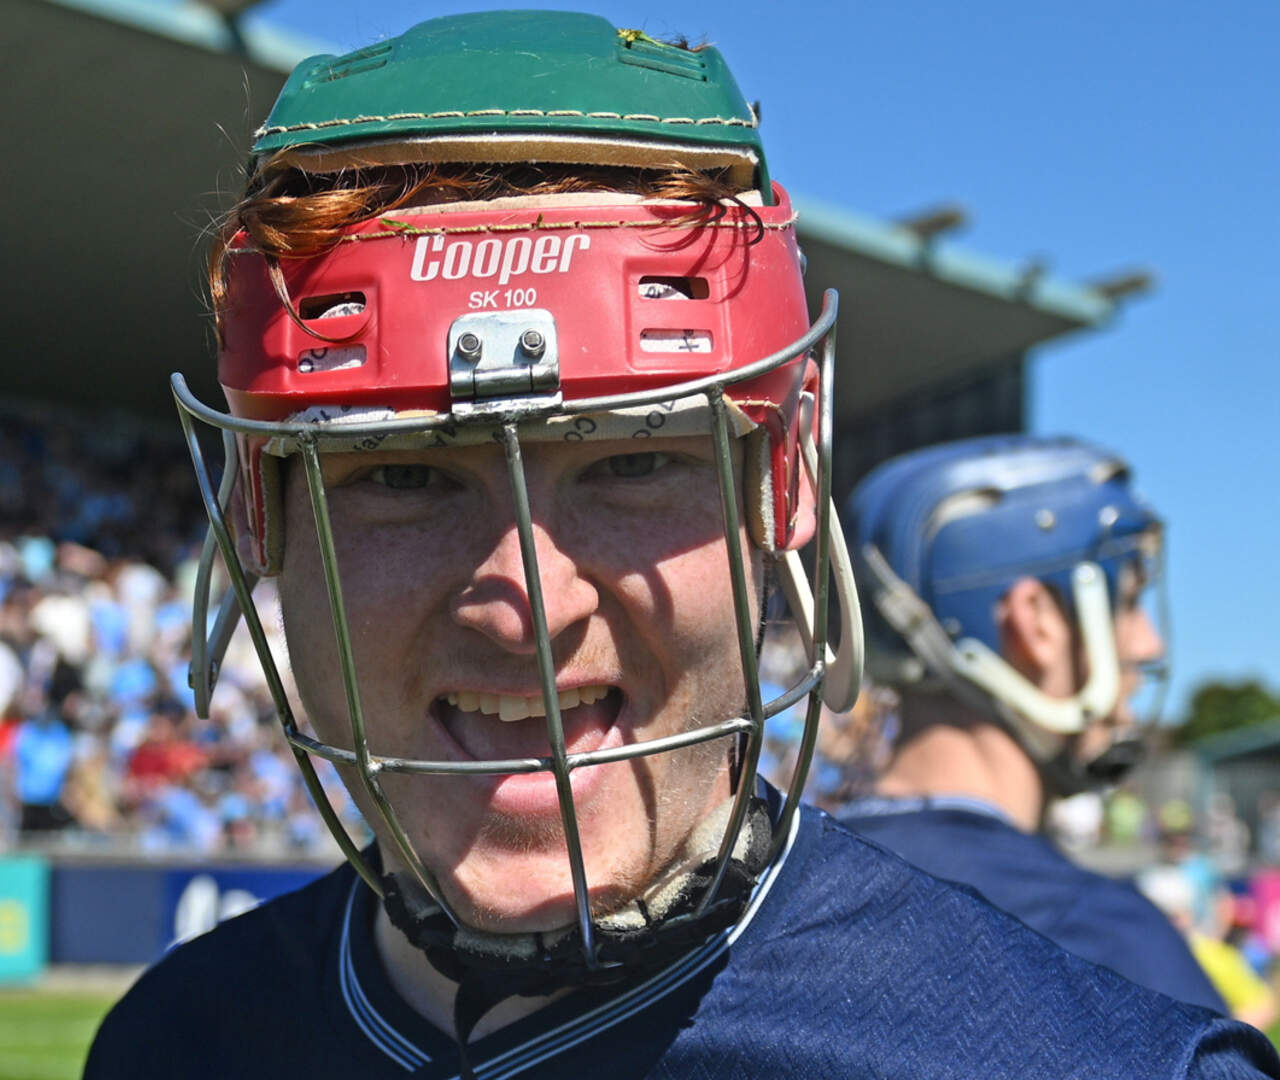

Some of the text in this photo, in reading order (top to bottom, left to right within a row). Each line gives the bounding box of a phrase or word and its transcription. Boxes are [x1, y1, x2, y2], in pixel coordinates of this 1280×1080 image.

[410, 234, 591, 285] Cooper
[468, 288, 537, 309] SK 100
